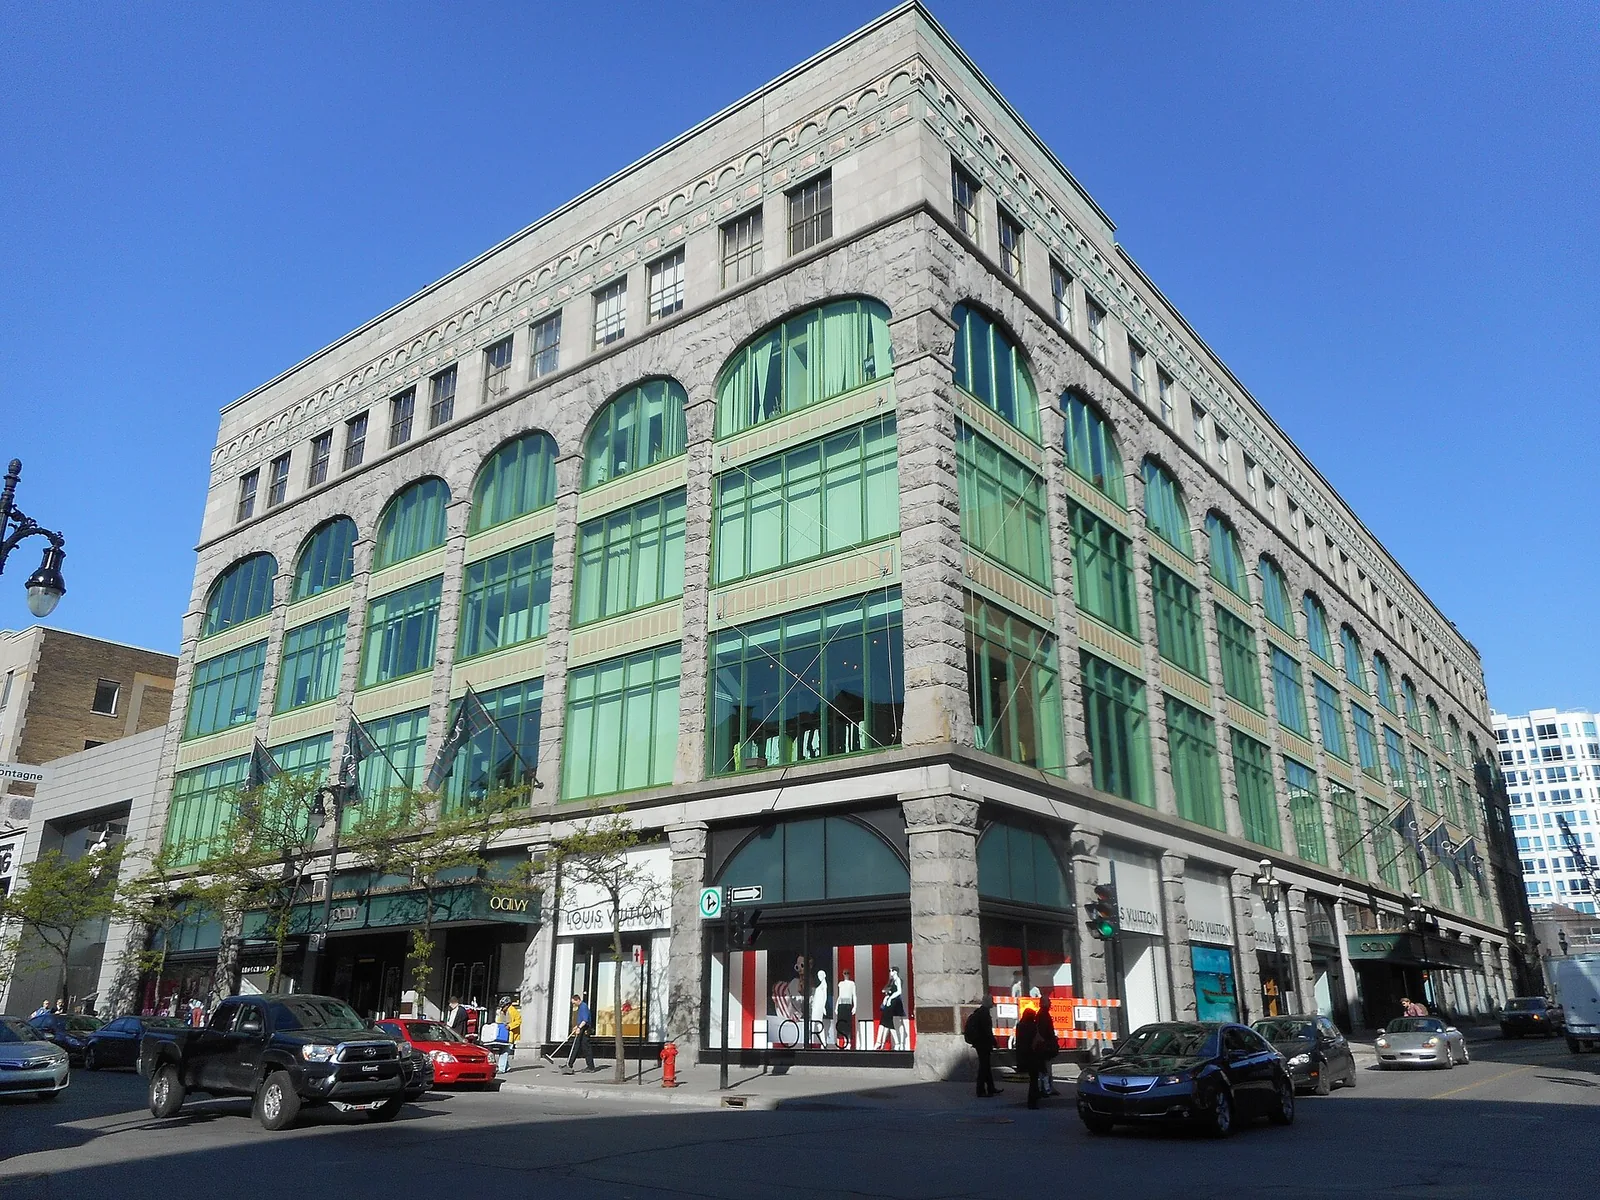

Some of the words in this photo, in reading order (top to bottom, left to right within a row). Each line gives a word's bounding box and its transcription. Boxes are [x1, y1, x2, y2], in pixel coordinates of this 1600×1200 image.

[490, 896, 529, 911] OGILVY
[567, 909, 602, 925] LOUIS
[1126, 907, 1159, 926] VUITTON
[1187, 918, 1205, 933] LOUIS
[1205, 921, 1231, 937] VUITTON
[752, 1019, 874, 1049] HORST
